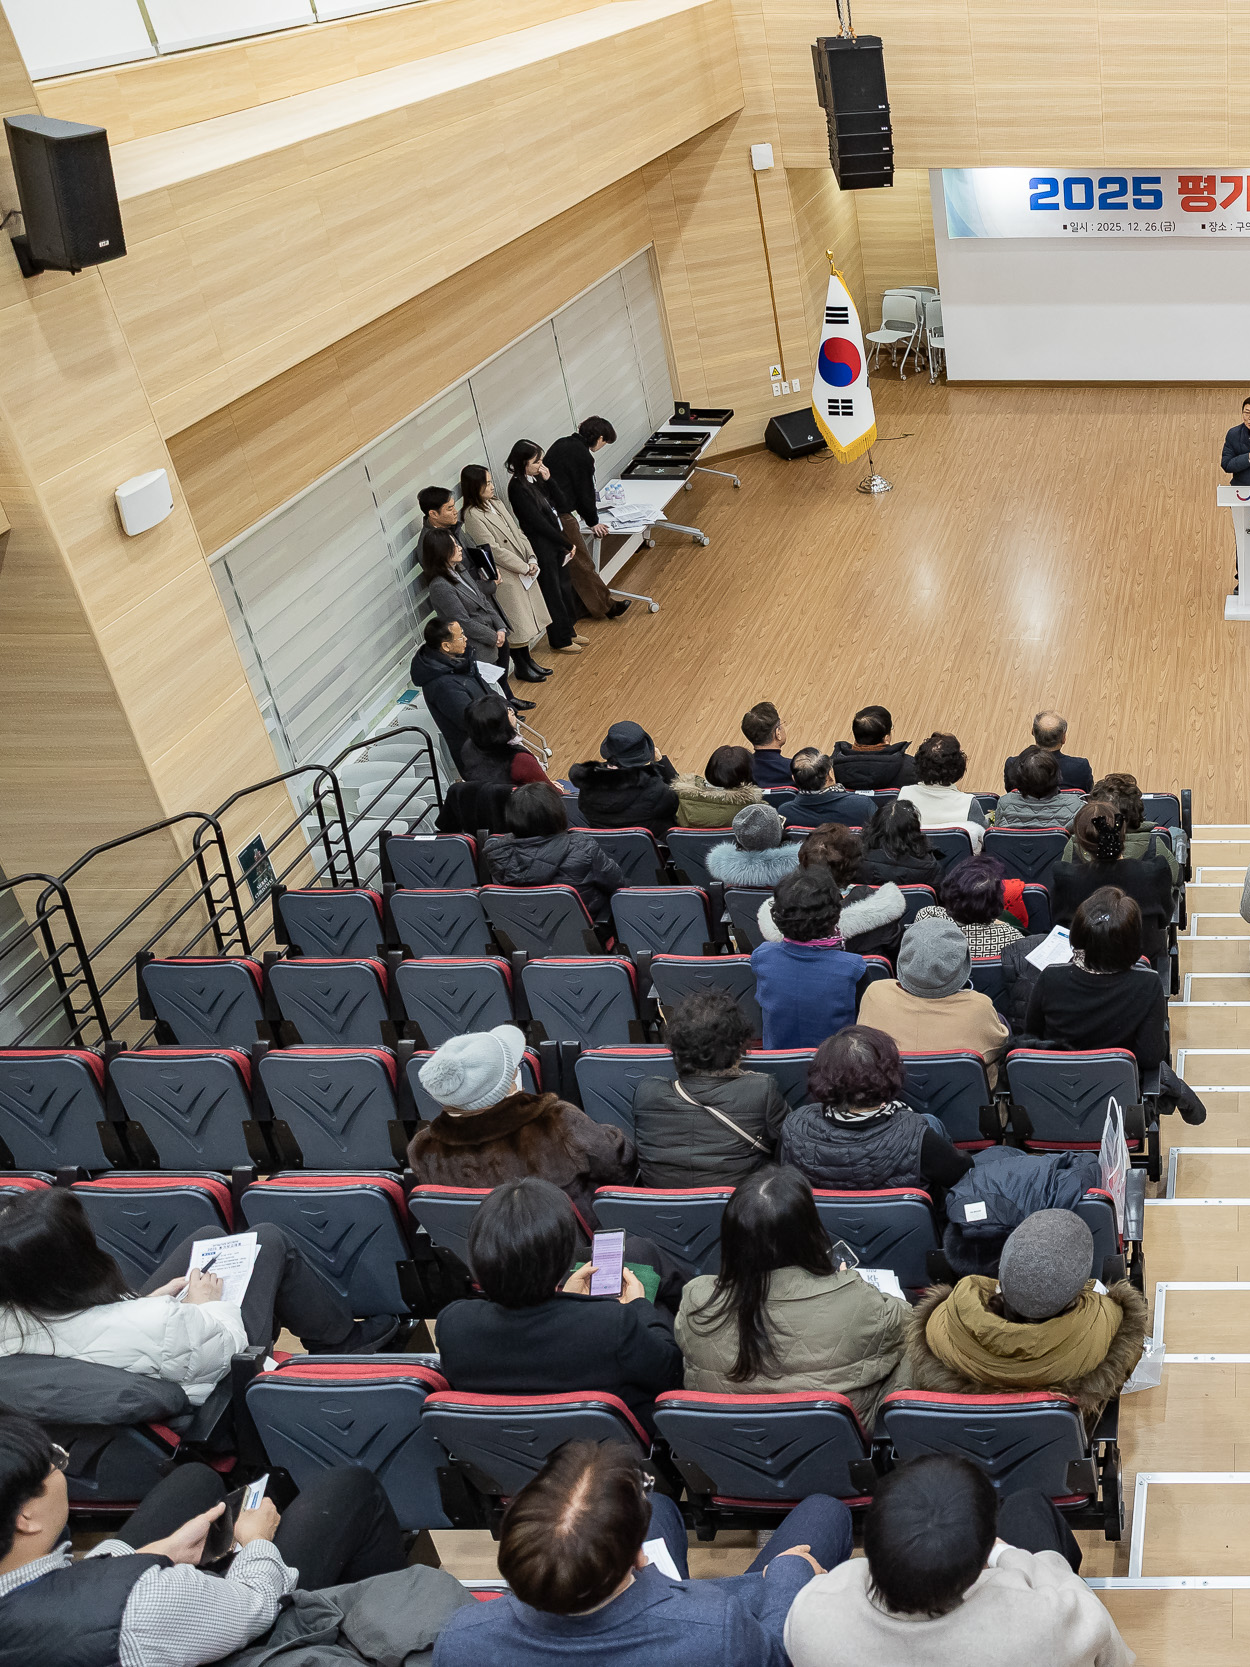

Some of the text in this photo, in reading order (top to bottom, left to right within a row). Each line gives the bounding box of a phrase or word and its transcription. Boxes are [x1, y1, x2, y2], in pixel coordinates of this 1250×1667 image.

[1029, 176, 1163, 211] 2025
[1069, 221, 1088, 232] 일시
[1097, 222, 1125, 232] 2025.
[1128, 222, 1142, 232] 12.
[1145, 221, 1176, 232] 26.(금)
[1208, 221, 1227, 233] 장소
